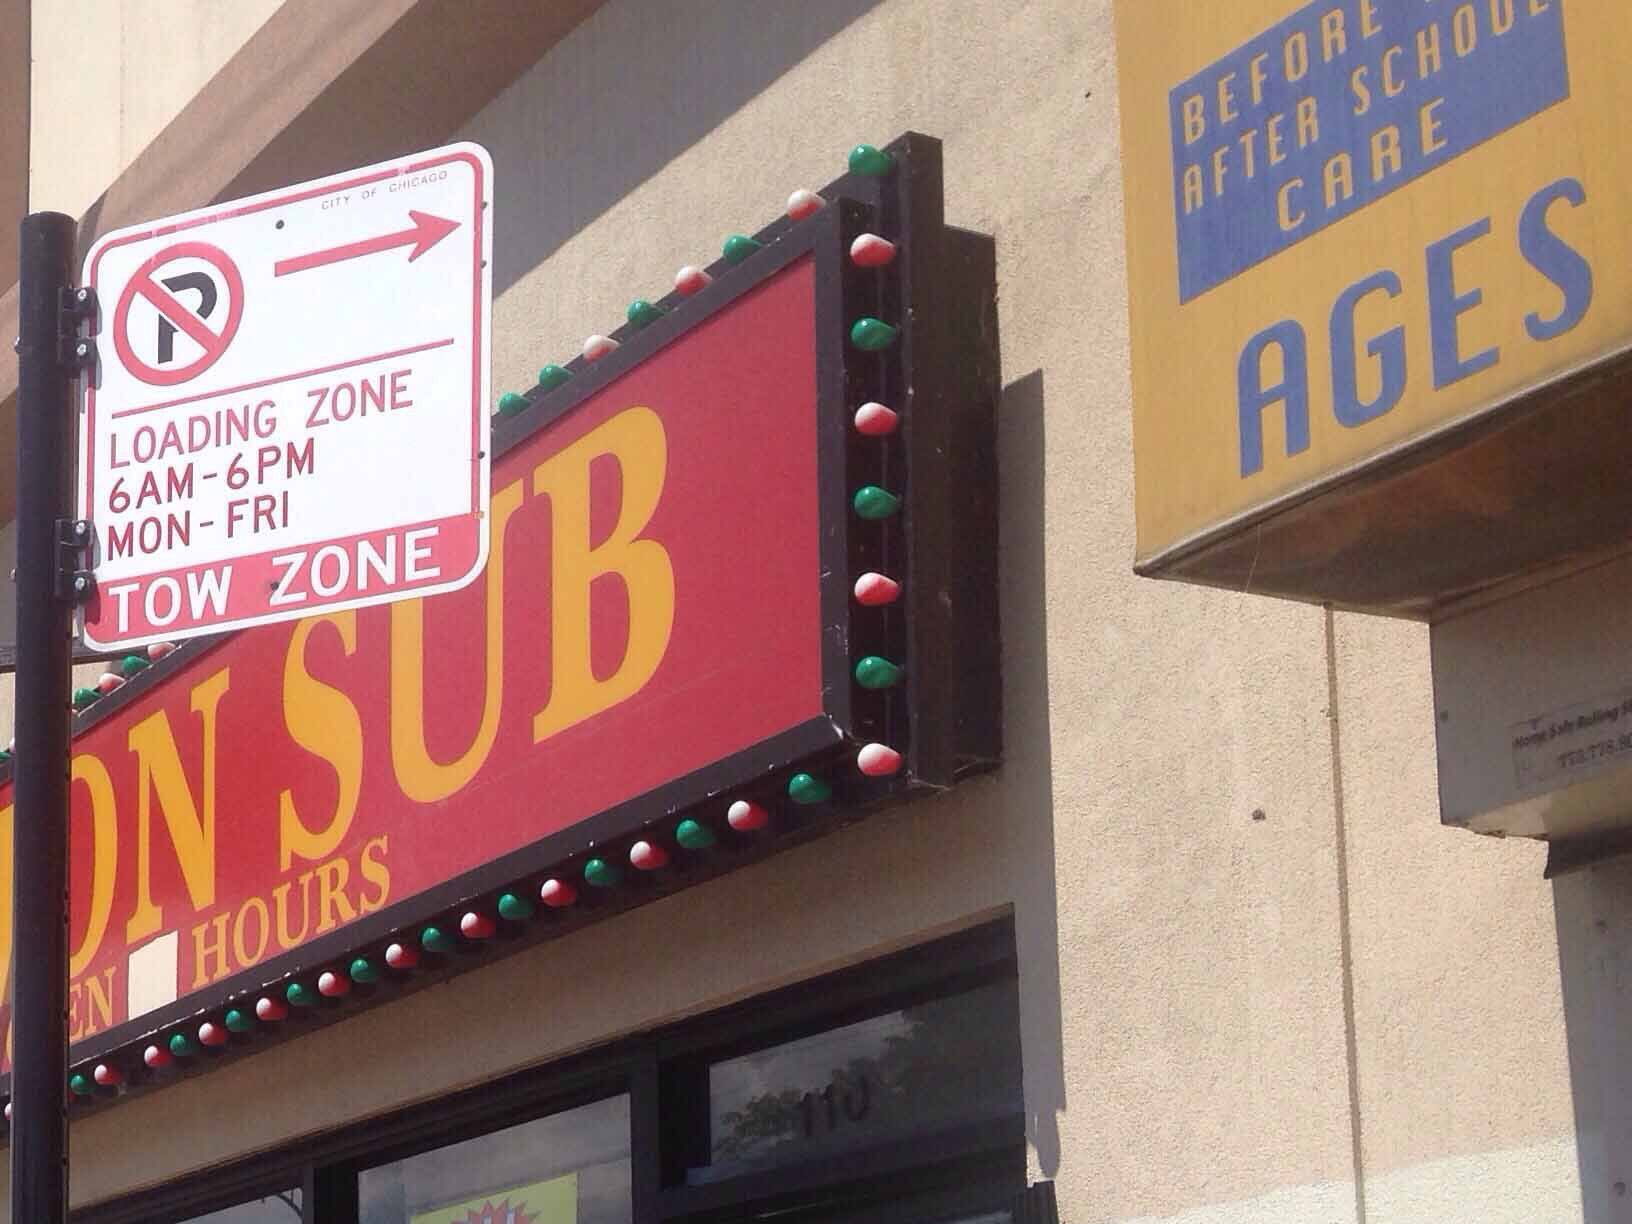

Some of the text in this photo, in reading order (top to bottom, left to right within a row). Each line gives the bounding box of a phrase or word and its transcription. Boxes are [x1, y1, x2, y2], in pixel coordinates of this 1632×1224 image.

[1182, 0, 1383, 146] BEFORE
[321, 170, 448, 210] CITY OF CHICAGO
[1183, 95, 1320, 216] AFTER
[1276, 97, 1449, 234] CARE
[1236, 176, 1595, 480] AGES
[108, 438, 315, 514] 6AM-6PM
[110, 369, 413, 470] LOADING ZONE
[107, 491, 290, 562] MON-FRI
[110, 526, 441, 634] TOW ZONE
[280, 406, 675, 872] SUB
[192, 833, 391, 990] HOURS
